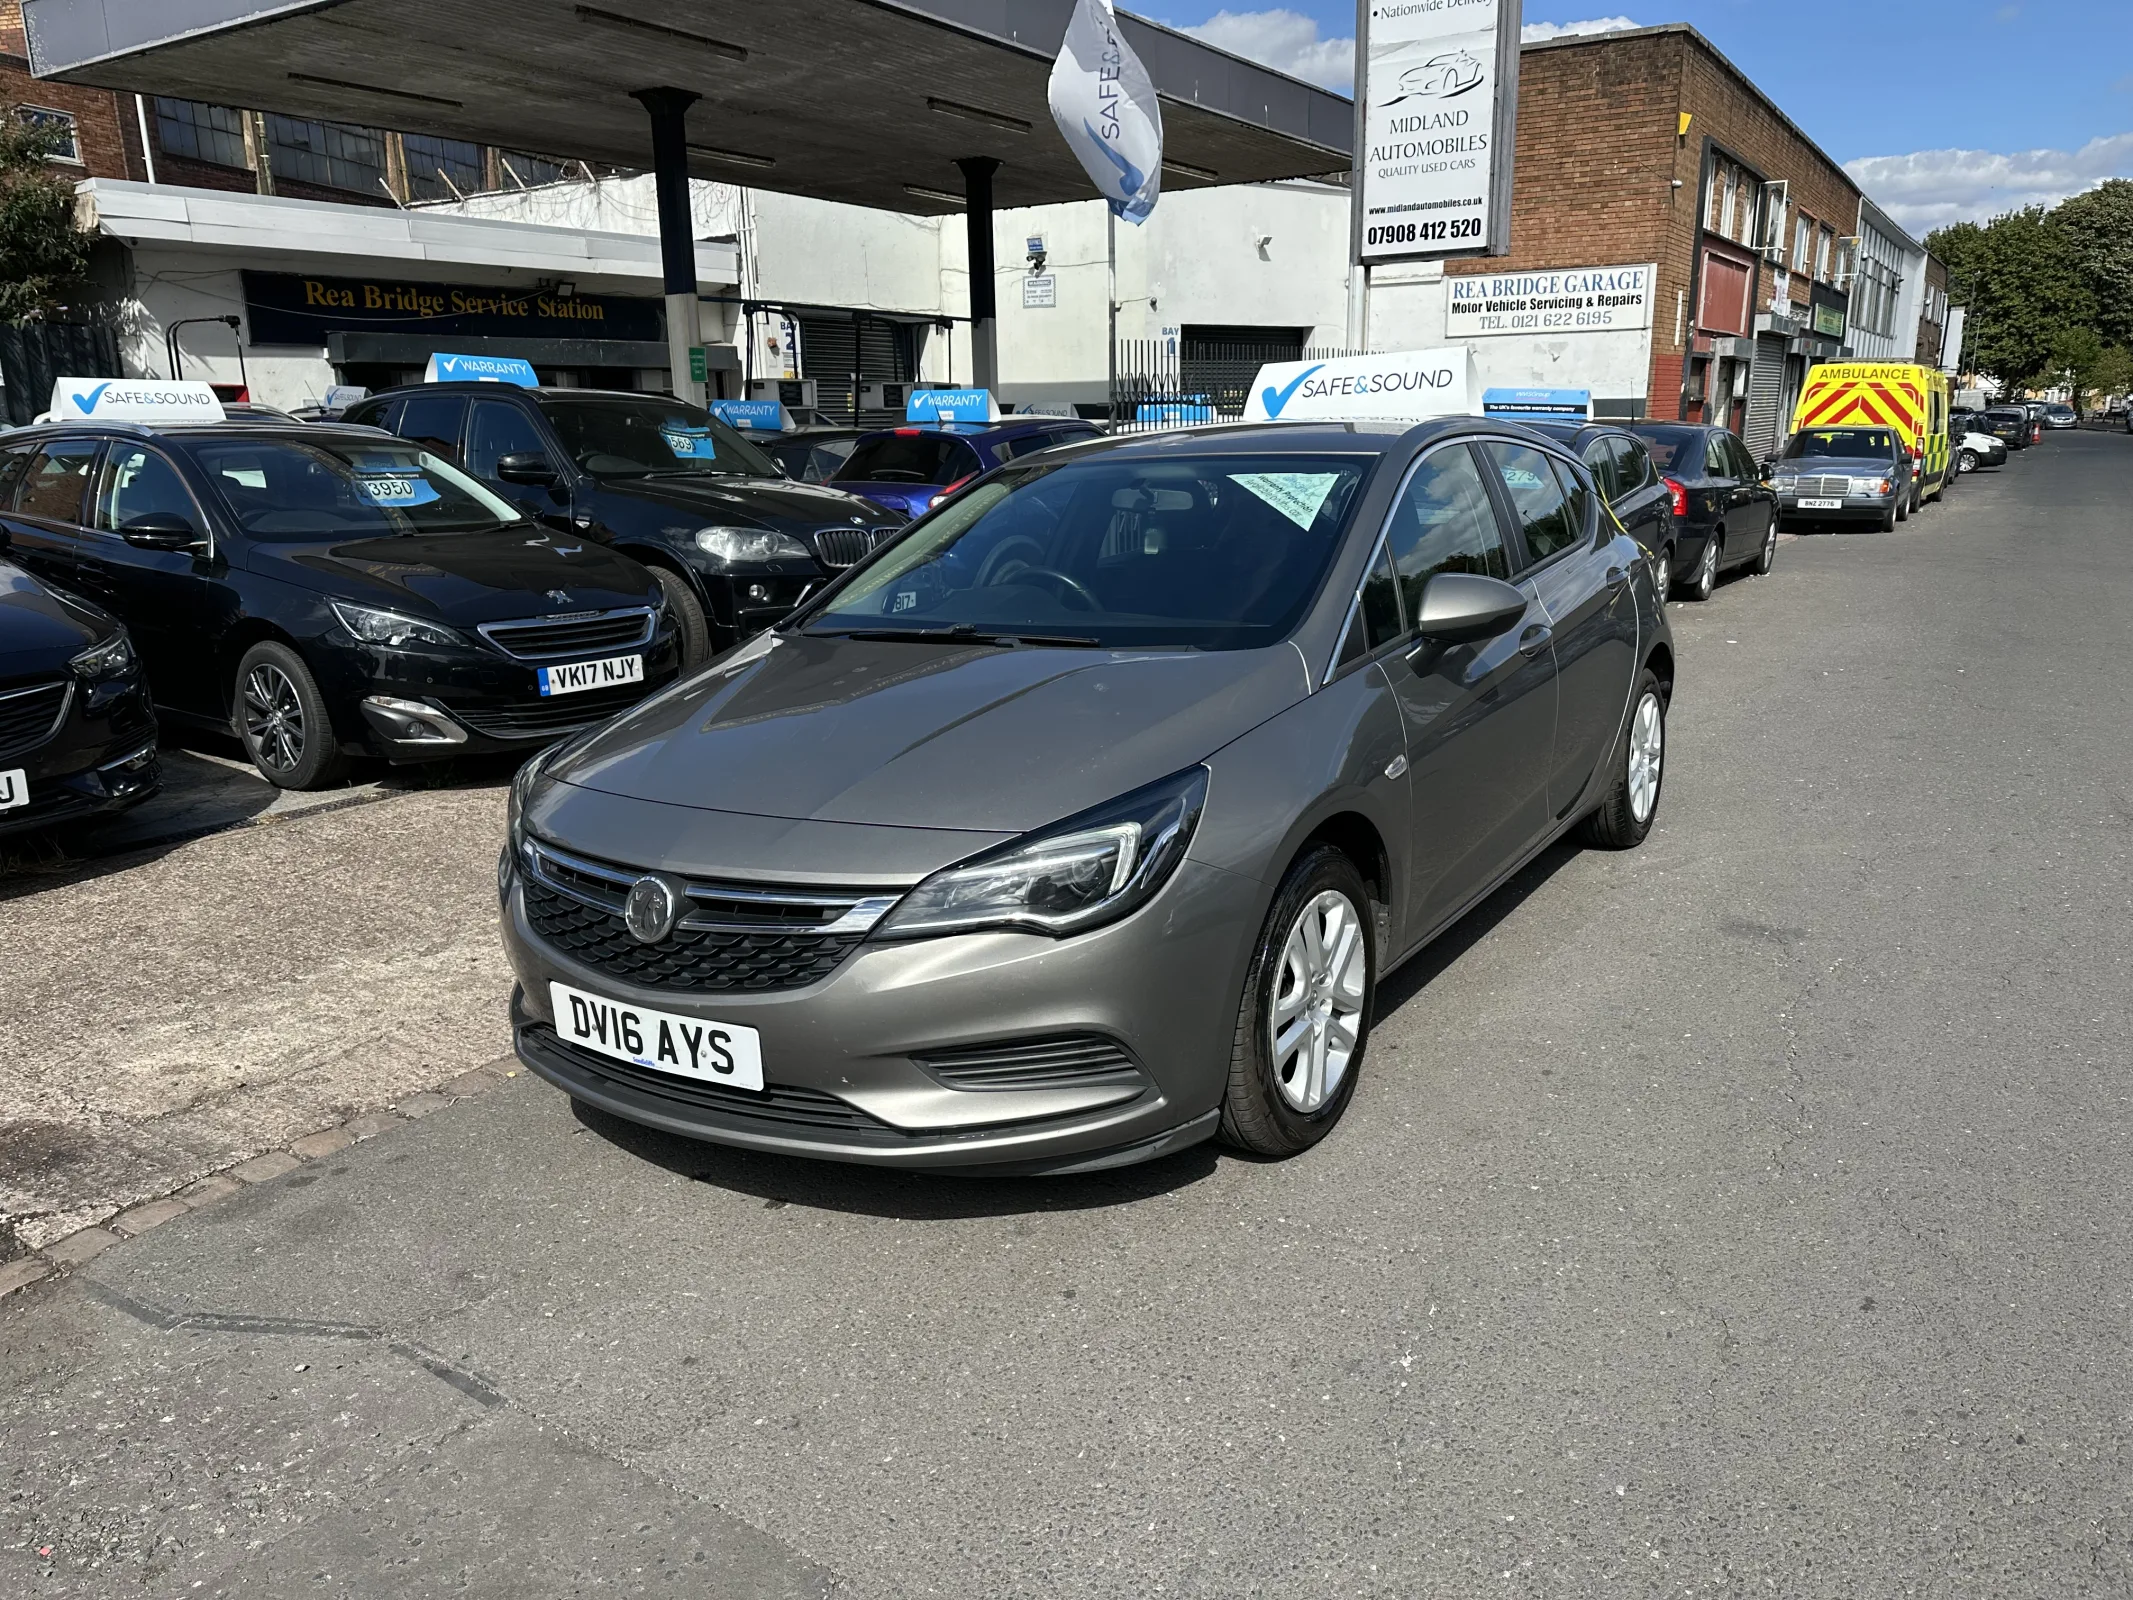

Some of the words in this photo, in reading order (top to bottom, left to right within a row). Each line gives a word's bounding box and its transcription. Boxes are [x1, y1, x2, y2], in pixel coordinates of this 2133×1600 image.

[1380, 0, 1443, 19] Nationwide
[1390, 110, 1469, 134] MIDLAND
[1369, 134, 1488, 162] AUTOMOBILES
[1378, 165, 1419, 179] QUALITY
[1421, 161, 1448, 174] USED
[1450, 158, 1476, 170] CARS
[1368, 197, 1483, 215] www.midlandautomobiles.co.uk
[1367, 223, 1416, 245] 07908
[1420, 221, 1447, 240] 412
[1450, 218, 1482, 238] 520
[1453, 281, 1487, 299] REA
[1492, 275, 1560, 297] BRIDGE
[1564, 270, 1644, 292] GARAGE
[303, 281, 355, 307] Rea
[363, 284, 444, 317] Bridge
[451, 290, 529, 316] Service
[537, 296, 605, 320] Station
[1452, 302, 1482, 314] Motor
[1485, 297, 1527, 312] Vehicle
[1529, 296, 1583, 311] Servicing
[1586, 296, 1594, 307] &
[1597, 293, 1642, 308] Repairs
[1479, 315, 1508, 329] TEL.
[1511, 314, 1538, 328] 0121
[1543, 313, 1571, 327] 622
[1576, 310, 1612, 325] 6195
[1162, 327, 1179, 335] BAY
[785, 332, 794, 350] 2
[1167, 337, 1175, 354] 1
[459, 360, 528, 376] WARRANTY
[1819, 368, 1911, 380] AMBULANCE
[1302, 369, 1453, 398] SAFE&SOUND
[104, 391, 210, 405] SAFE&SOUND
[927, 394, 983, 407] WARRANTY
[726, 404, 775, 416] WARRANTY
[555, 663, 597, 688] VK17
[602, 657, 635, 681] NJY
[568, 994, 644, 1056] DV16
[657, 1019, 735, 1075] AYS
